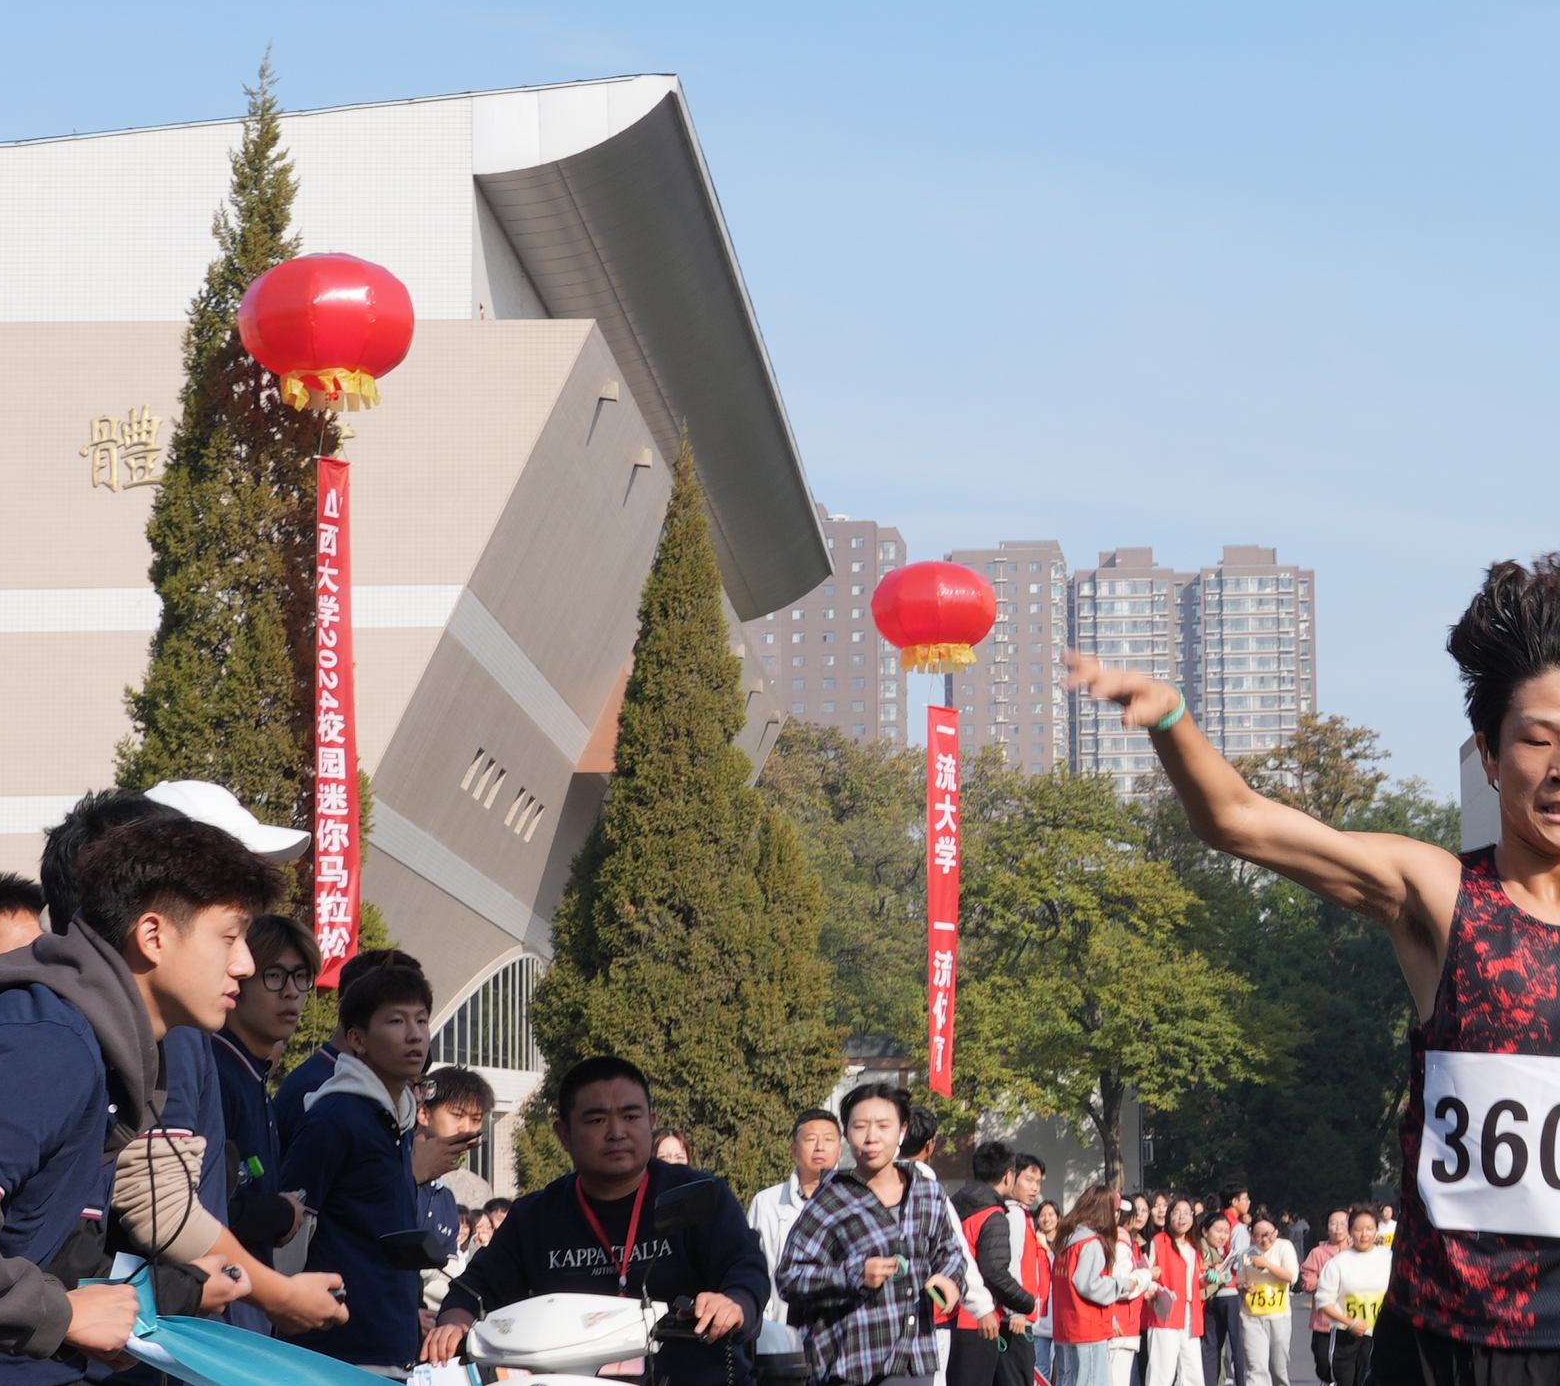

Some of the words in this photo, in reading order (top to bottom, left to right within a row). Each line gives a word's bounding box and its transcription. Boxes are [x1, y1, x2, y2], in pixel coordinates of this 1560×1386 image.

[316, 487, 353, 960] 山西大学2024校园迷你马拉松
[934, 723, 958, 875] 一流大学
[548, 1246, 608, 1270] KAPPA
